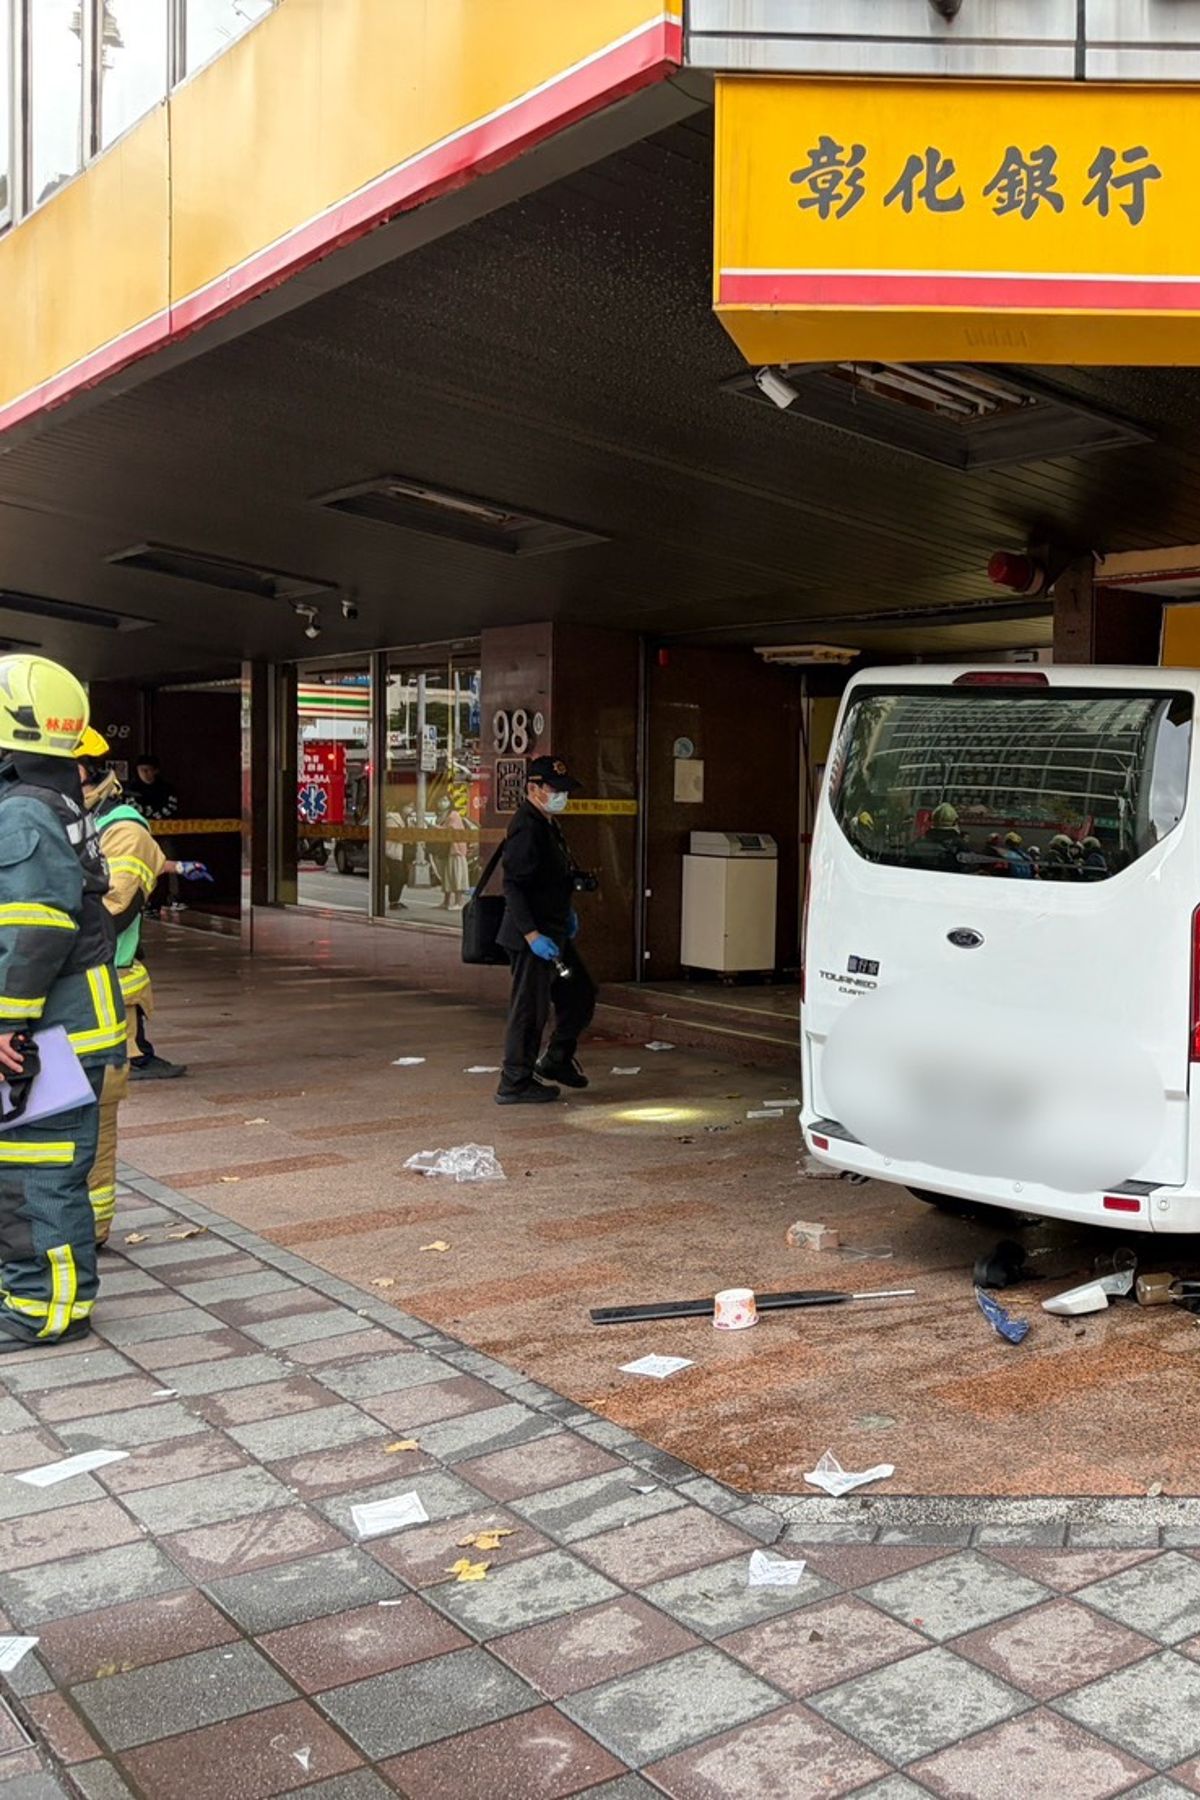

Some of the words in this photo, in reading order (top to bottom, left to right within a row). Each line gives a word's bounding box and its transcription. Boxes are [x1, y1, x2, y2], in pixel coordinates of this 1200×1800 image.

[790, 136, 1162, 225] 彰化銀行
[106, 723, 131, 739] 98
[818, 969, 878, 990] TOURNEO
